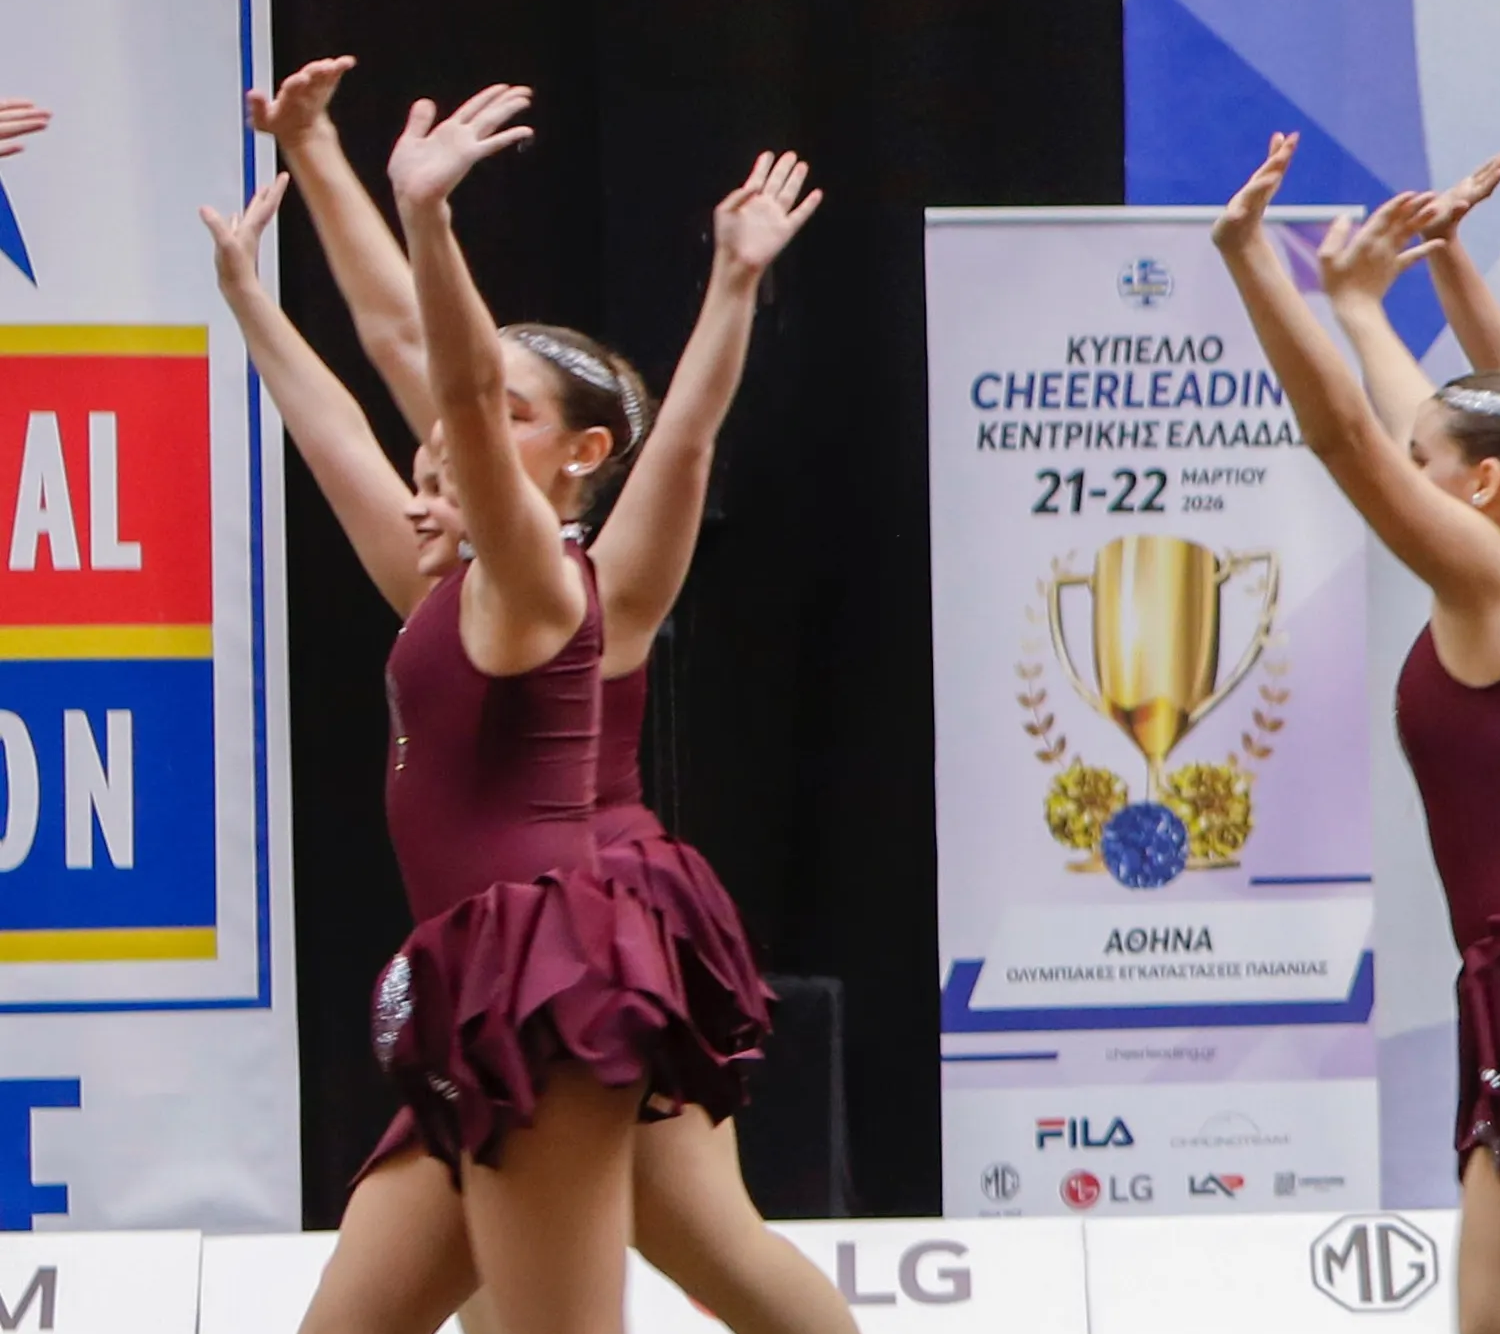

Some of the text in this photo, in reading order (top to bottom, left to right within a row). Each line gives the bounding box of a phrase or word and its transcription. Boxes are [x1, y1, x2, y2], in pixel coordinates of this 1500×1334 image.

[1066, 335, 1224, 365] ΚΥΠΕΛΛΟ
[970, 368, 1284, 410] CHEERLEADIN
[977, 419, 1308, 451] ΚΕΝΤΡΙΚΗΣ ΕΛΛΑΔΑ
[1032, 466, 1168, 514] 21-22
[1181, 467, 1267, 486] ΜΑΡΤΙΟΥ
[1104, 925, 1214, 955] ΑΘΗΝΑ
[1035, 1116, 1135, 1150] FILA
[1109, 1174, 1154, 1203] LG
[836, 1239, 973, 1305] LG
[1322, 1222, 1428, 1304] MG
